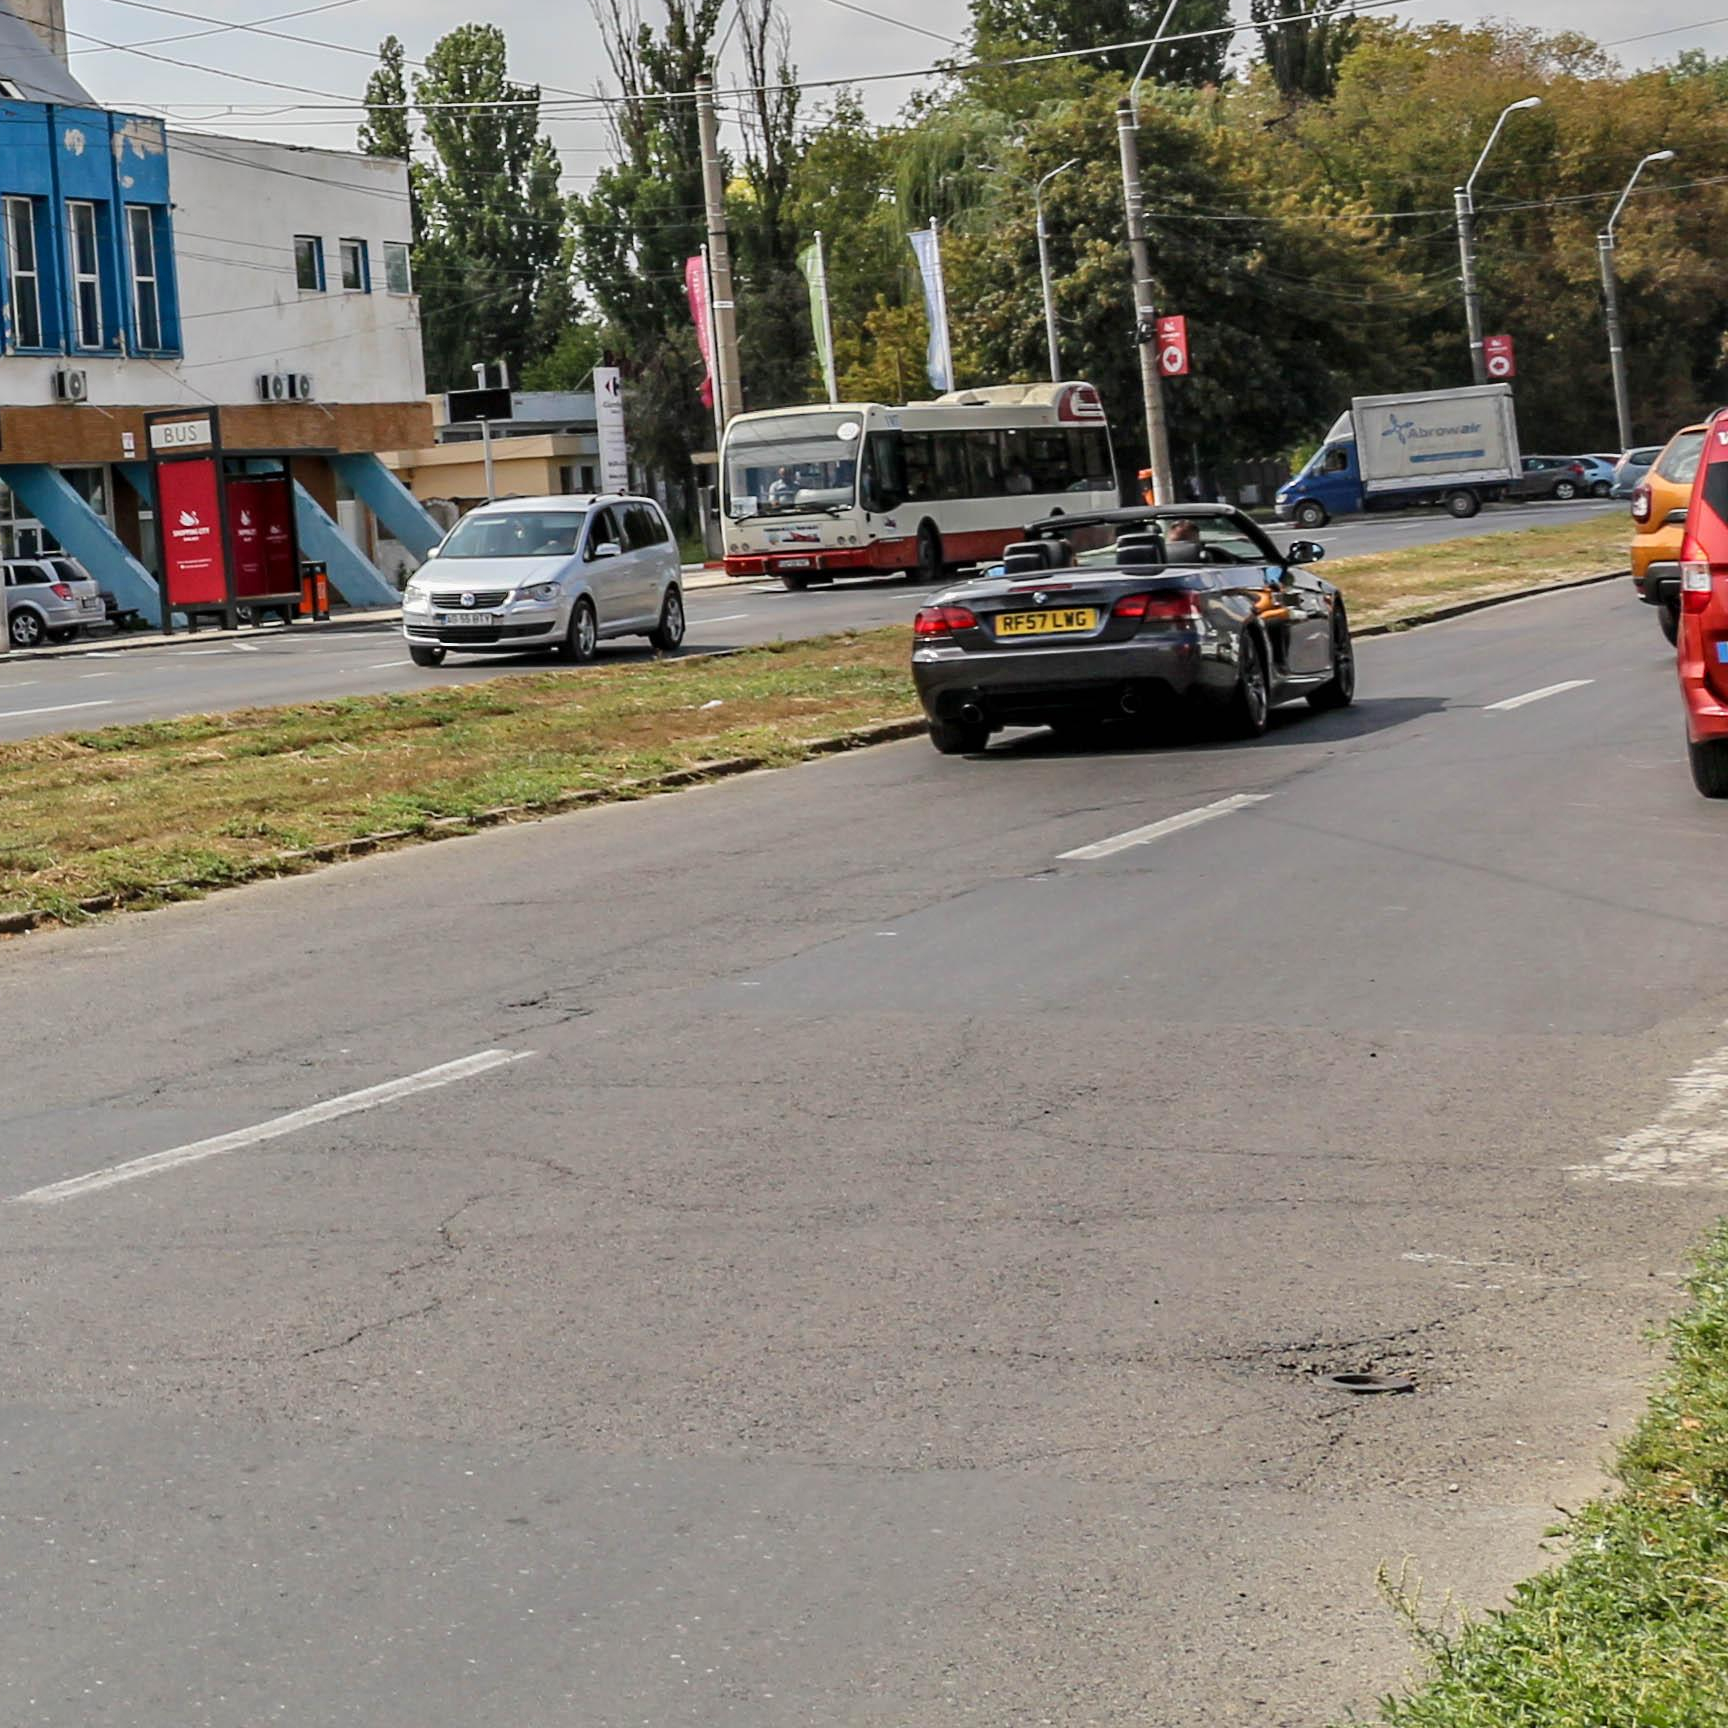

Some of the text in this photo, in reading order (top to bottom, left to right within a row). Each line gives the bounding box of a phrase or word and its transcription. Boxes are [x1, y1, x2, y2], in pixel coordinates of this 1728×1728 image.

[163, 424, 198, 443] BUS
[1002, 611, 1086, 631] RF57 LWG
